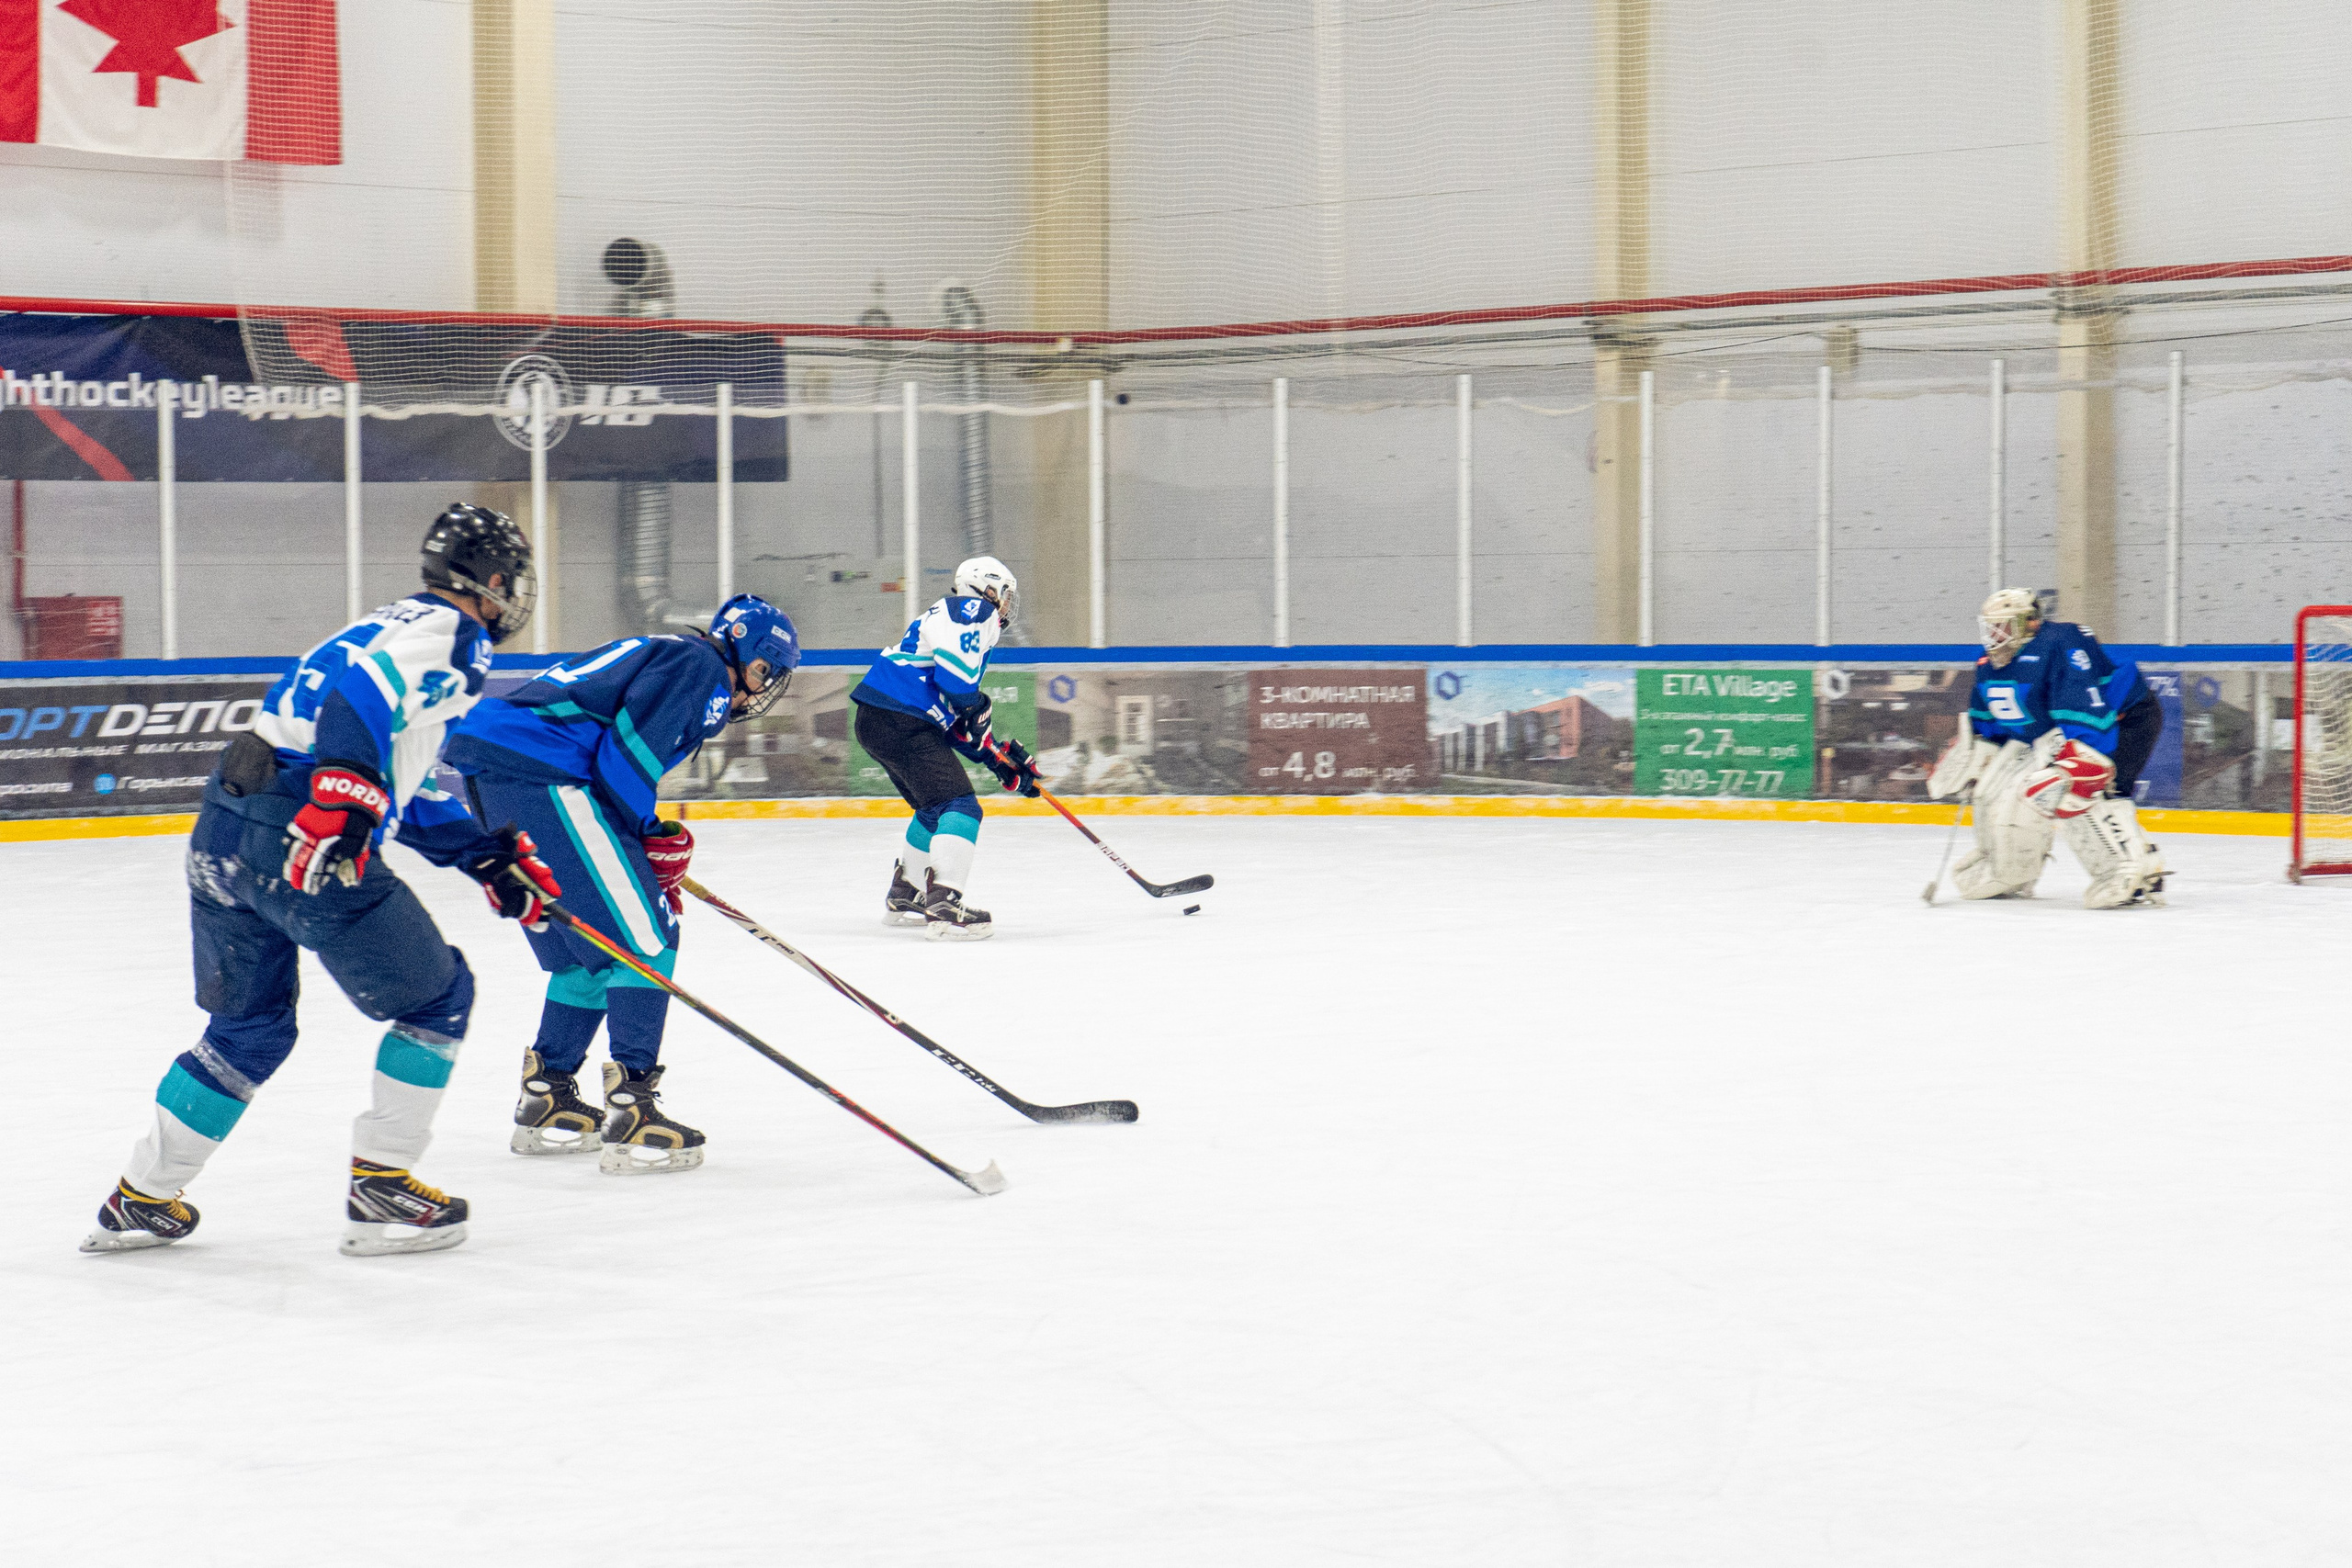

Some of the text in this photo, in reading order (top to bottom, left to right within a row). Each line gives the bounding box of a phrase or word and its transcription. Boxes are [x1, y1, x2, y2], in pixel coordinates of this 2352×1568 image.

[0, 369, 345, 421] hthockeyleague
[1260, 685, 1416, 704] 3-КОМНАТНАЯ
[1662, 674, 1798, 703] ETA Village
[2086, 687, 2106, 706] 1
[1260, 712, 1372, 729] КВАРТИРА
[1684, 728, 1735, 759] 2,7
[1283, 750, 1337, 782] 4,8
[1659, 768, 1785, 793] 309-77-77
[391, 1195, 429, 1213] CCM
[151, 1216, 175, 1230] CCM
